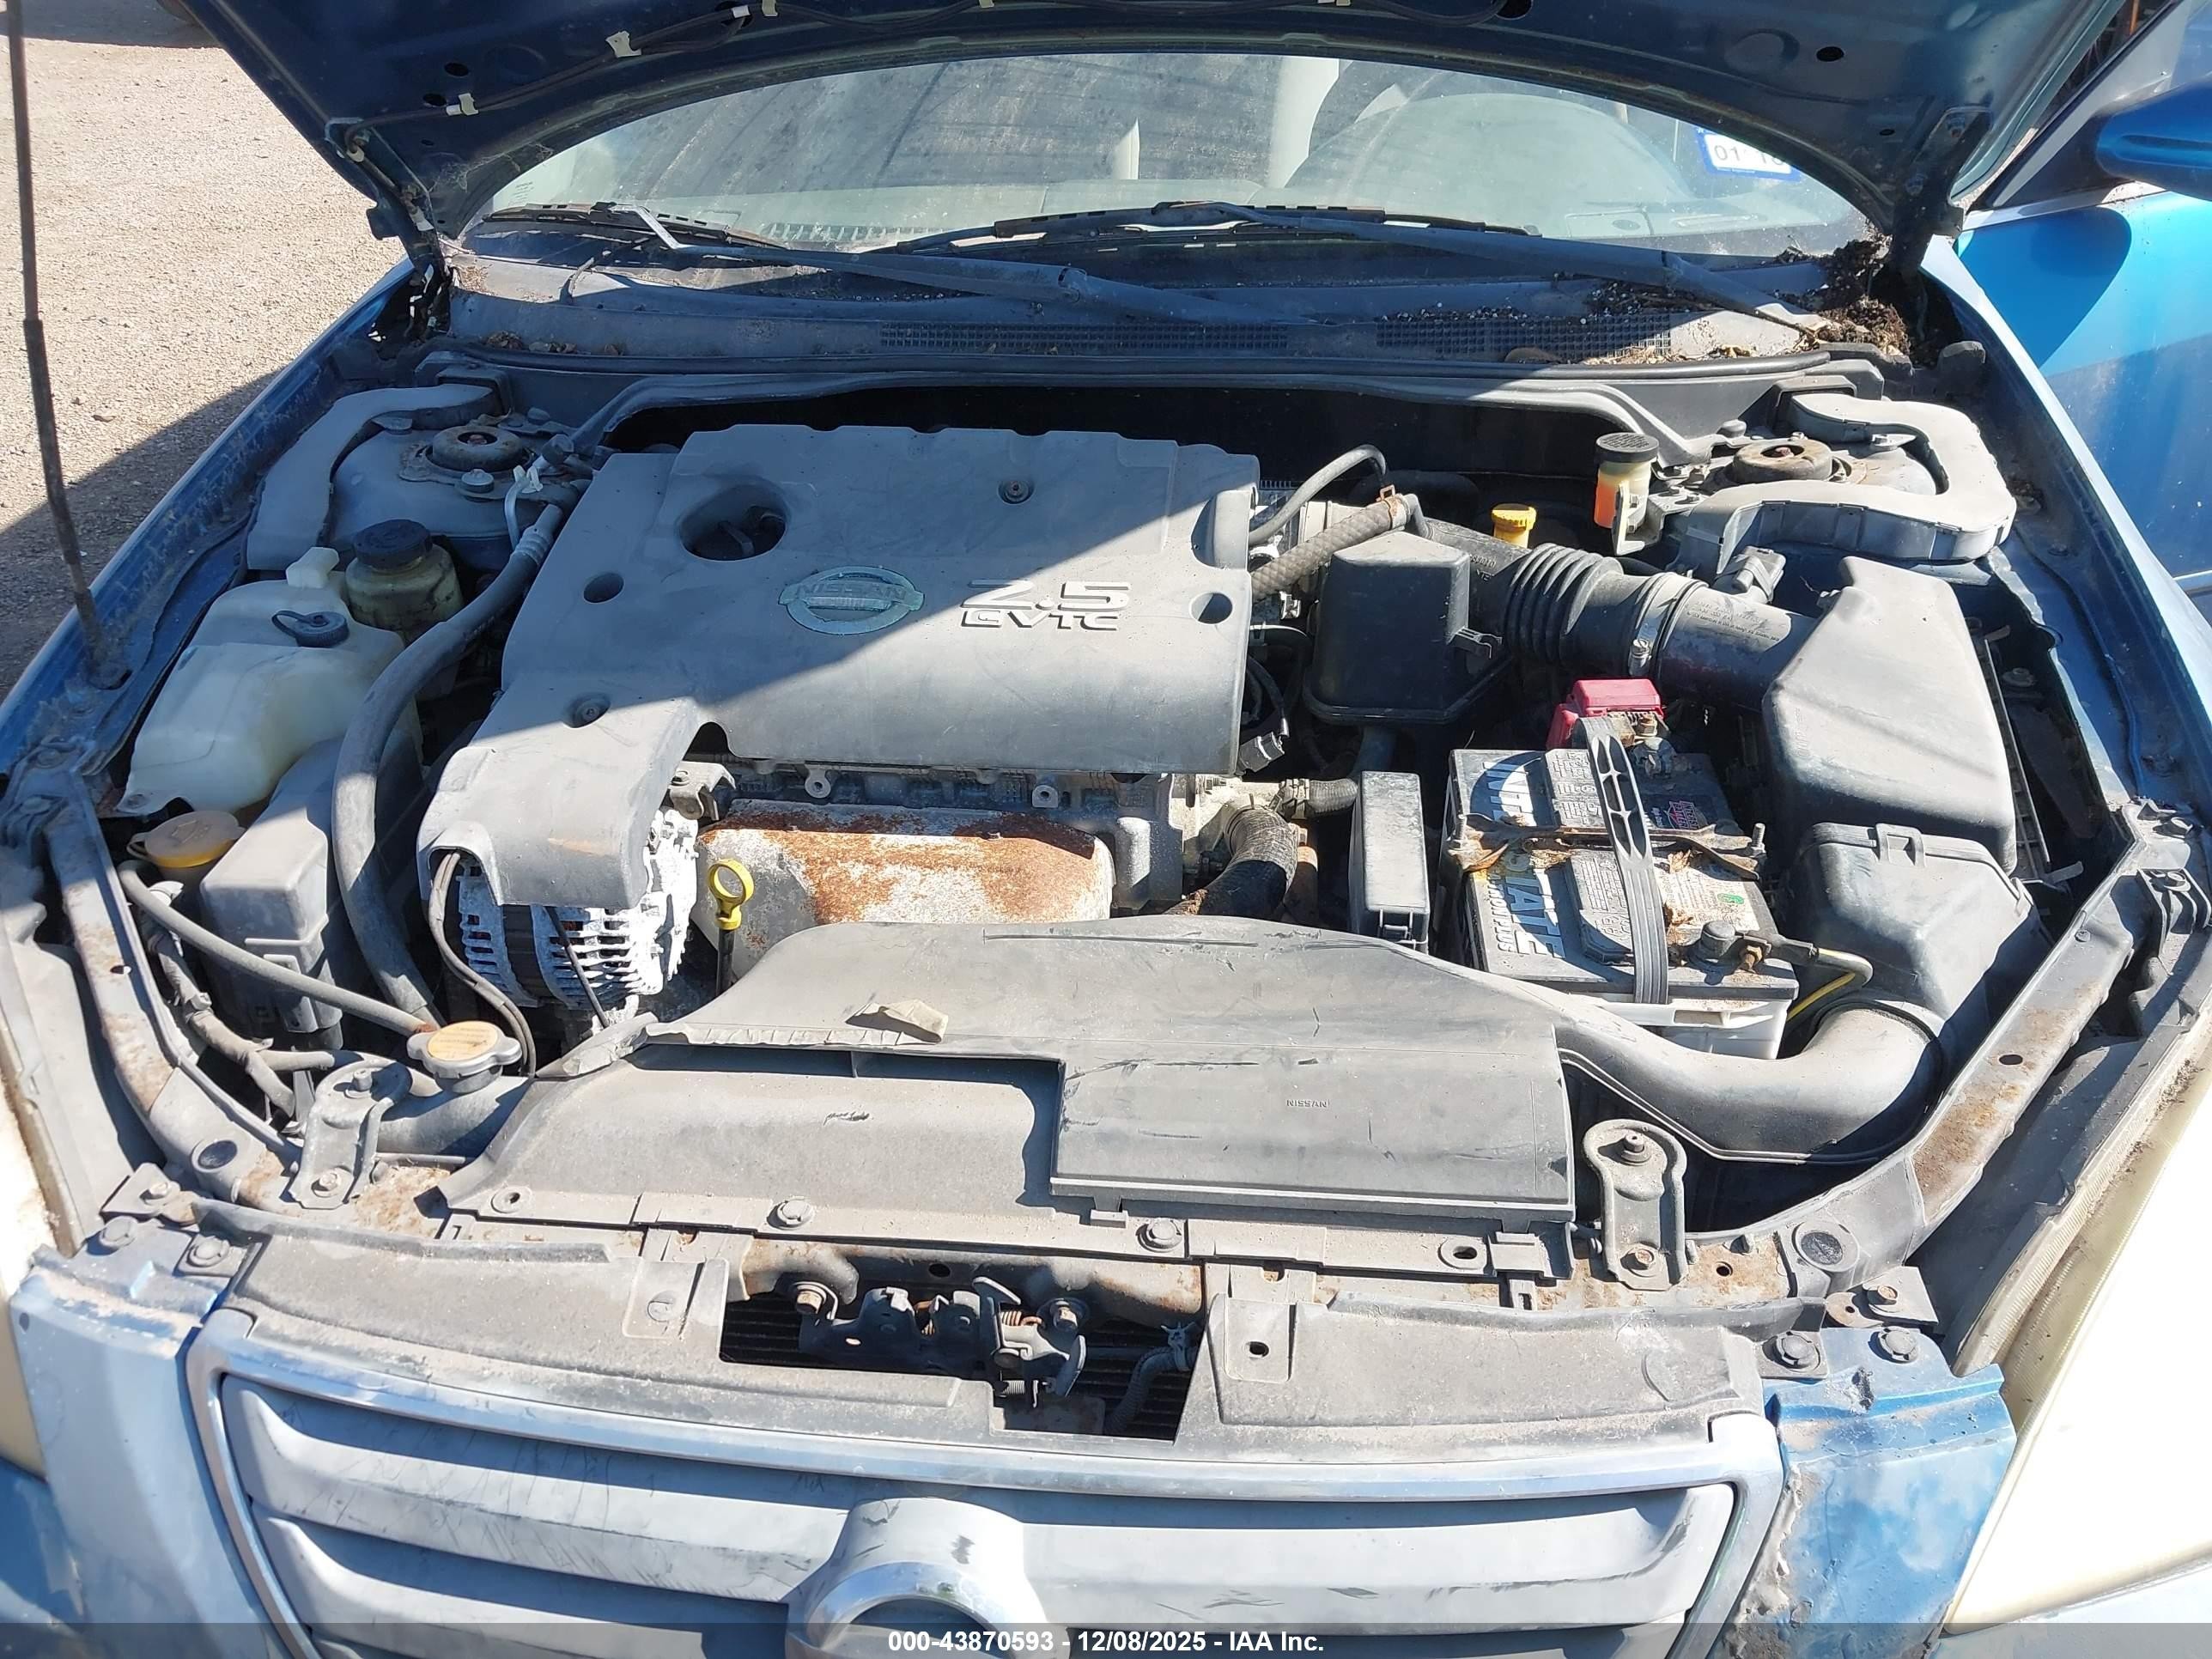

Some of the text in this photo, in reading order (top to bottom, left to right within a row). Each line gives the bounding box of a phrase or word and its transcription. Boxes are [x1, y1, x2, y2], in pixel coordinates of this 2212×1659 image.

[1714, 144, 1741, 161] 01
[796, 583, 907, 599] NISSAN
[960, 579, 1130, 612] 2.5
[1493, 918, 1513, 953] PLUS
[1286, 1098, 1328, 1109] NISSAN
